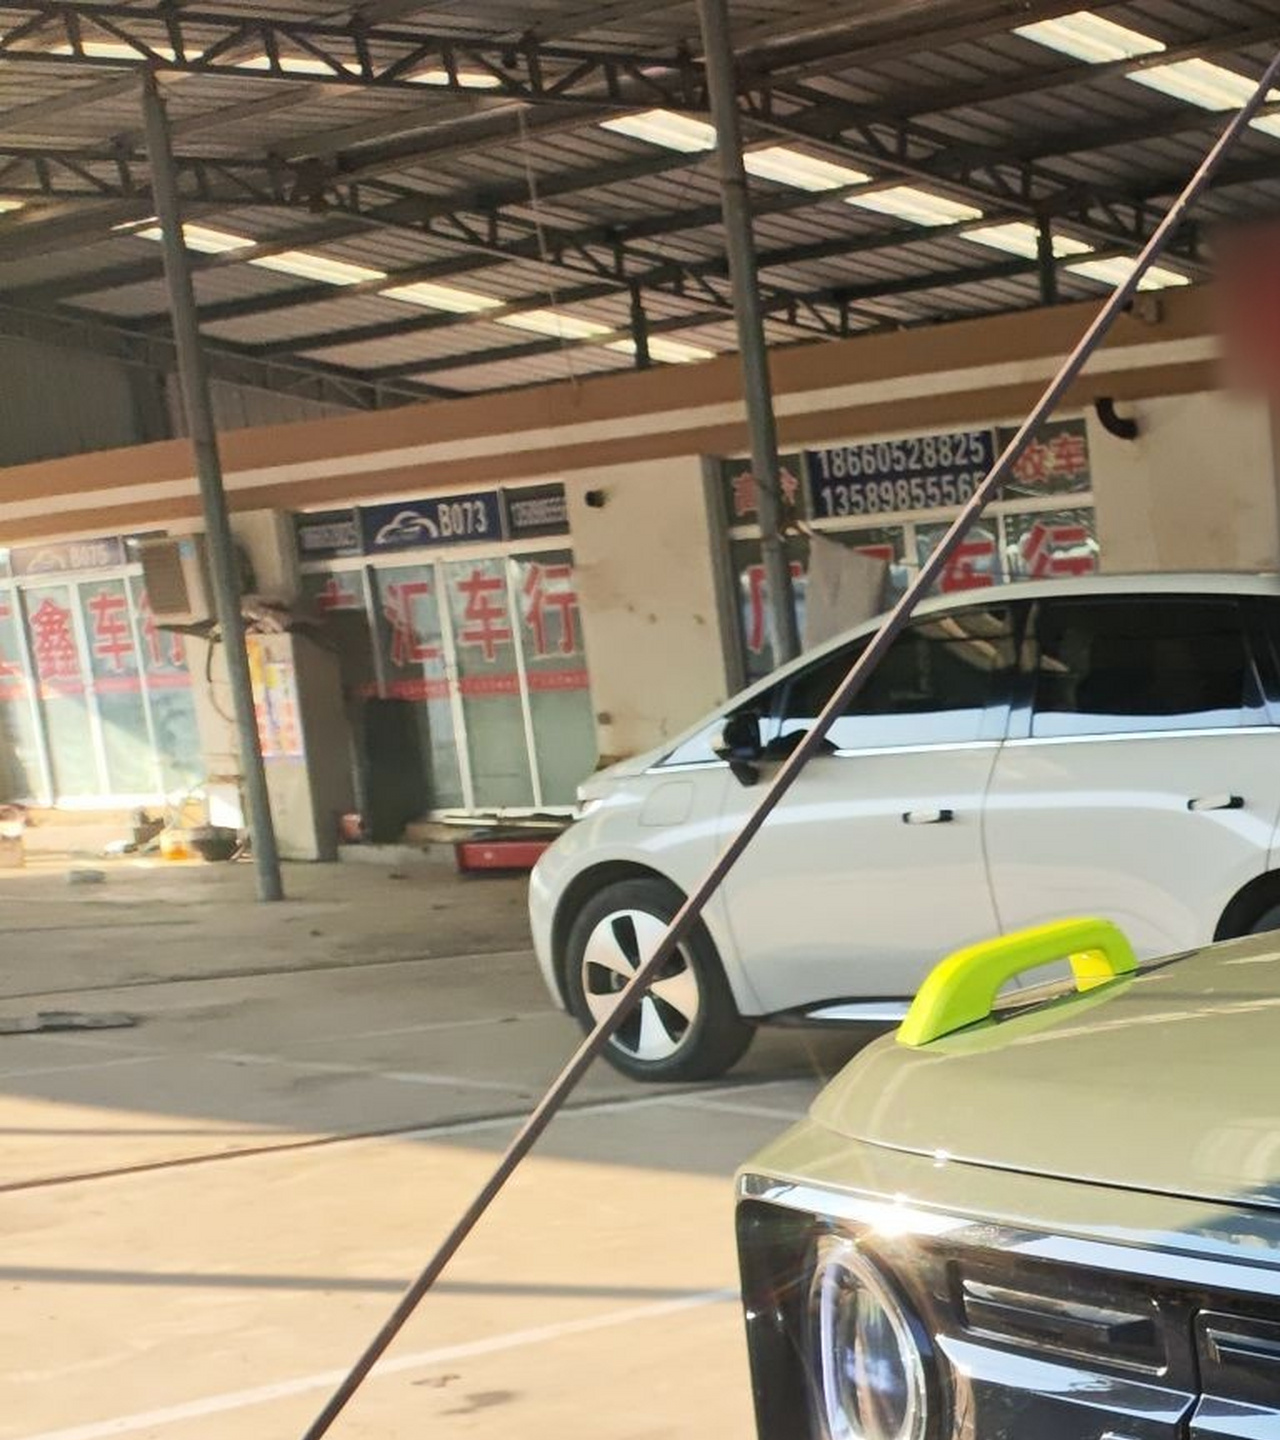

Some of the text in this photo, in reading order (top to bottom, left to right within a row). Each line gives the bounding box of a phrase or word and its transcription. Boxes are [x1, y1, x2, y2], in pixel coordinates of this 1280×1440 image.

[818, 433, 985, 479] 18660528825
[437, 501, 488, 537] B073
[319, 563, 579, 667] 汇车行
